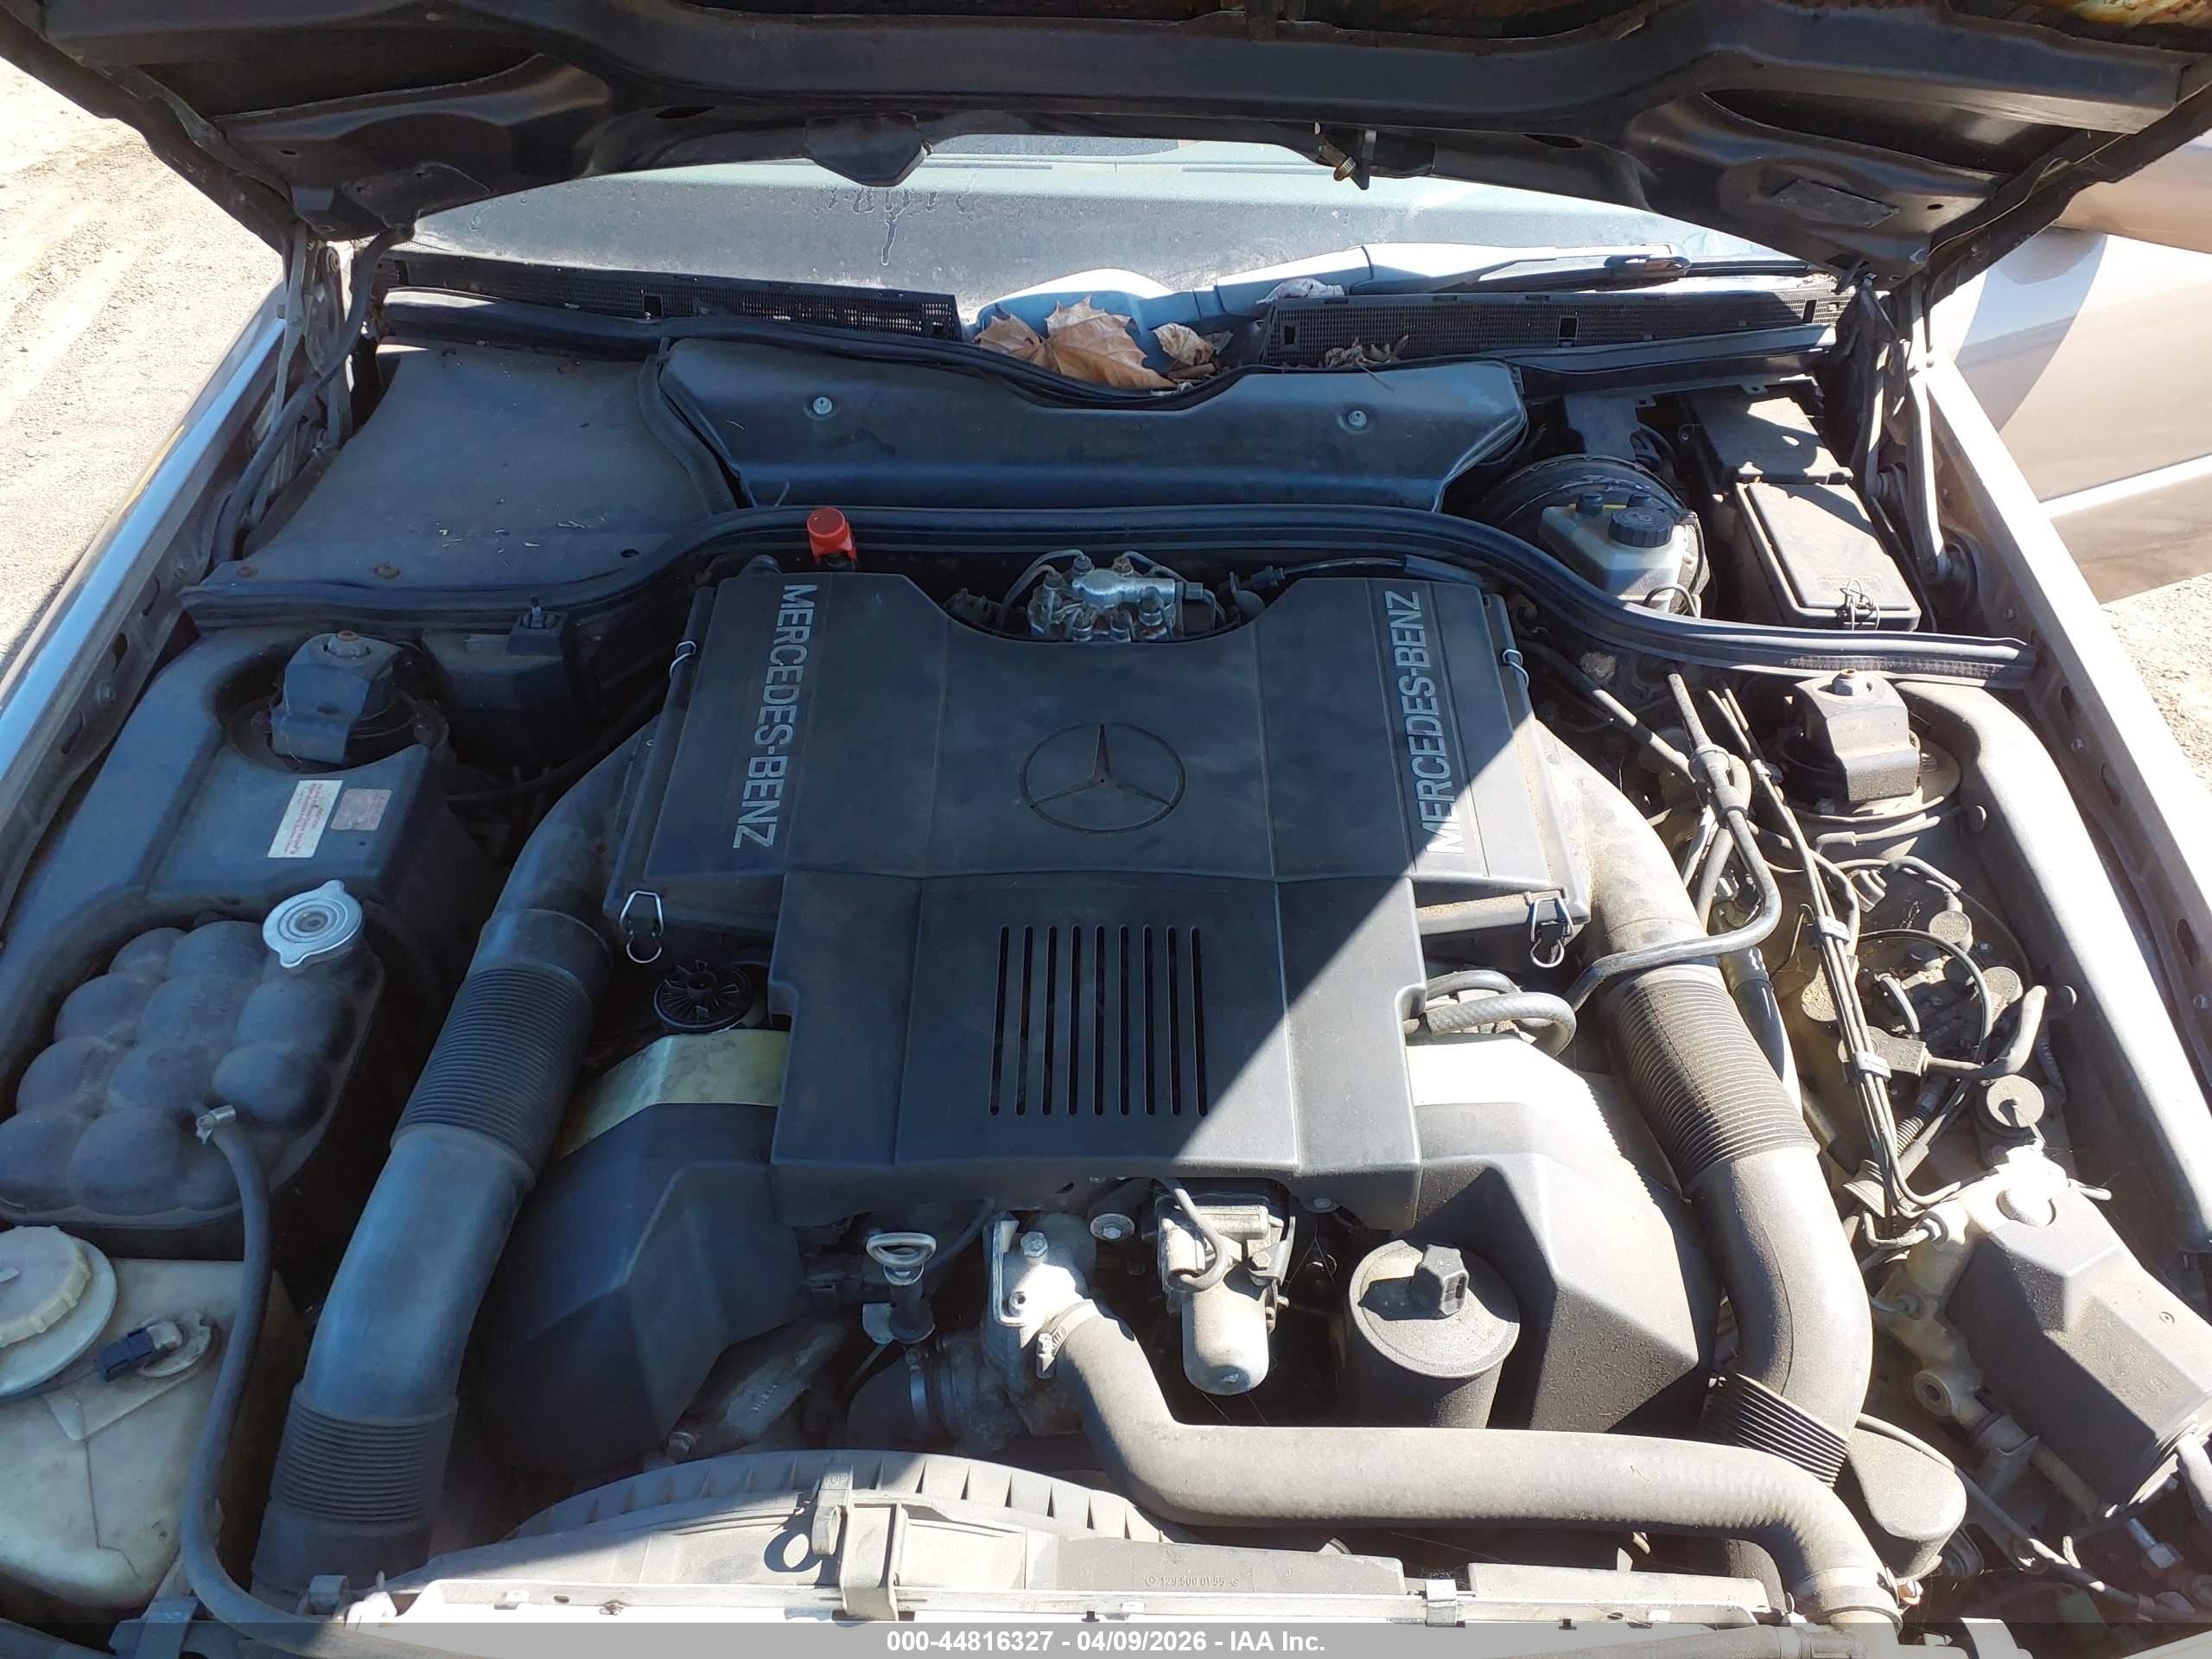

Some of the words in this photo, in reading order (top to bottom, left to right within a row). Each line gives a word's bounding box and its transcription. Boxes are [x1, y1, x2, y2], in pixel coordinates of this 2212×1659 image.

[733, 584, 818, 849] MERCEDES-BENZ
[1384, 590, 1466, 855] MERCEDES-BENZ
[1161, 1576, 1177, 1587] 129
